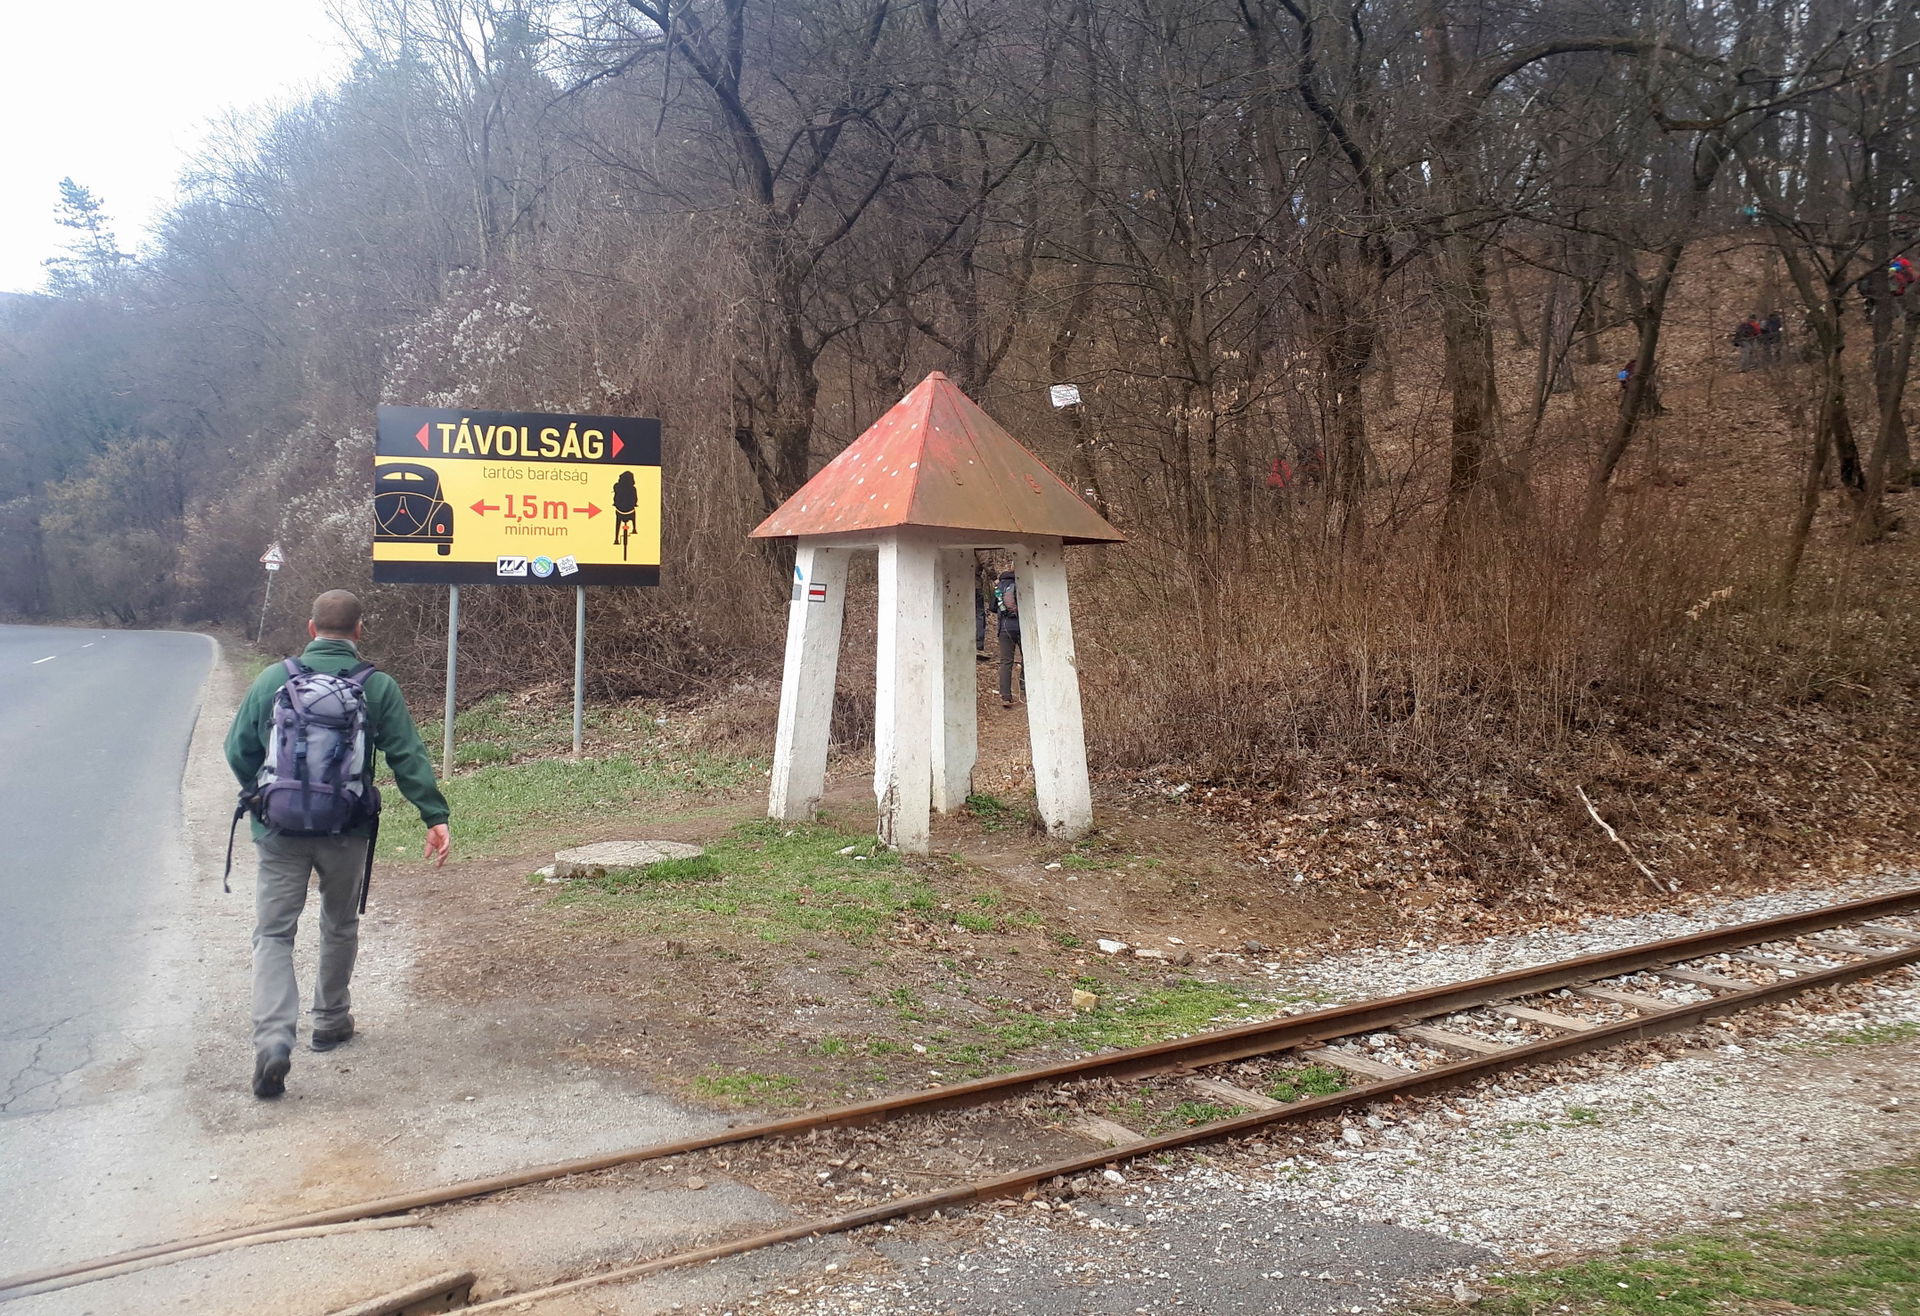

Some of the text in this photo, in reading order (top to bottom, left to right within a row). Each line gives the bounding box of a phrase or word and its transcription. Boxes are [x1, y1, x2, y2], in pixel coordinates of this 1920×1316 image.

[437, 418, 604, 460] TÁVOLSÁG
[483, 467, 588, 485] tartós barátság
[504, 494, 568, 523] 1,5 m
[505, 523, 568, 537] minimum
